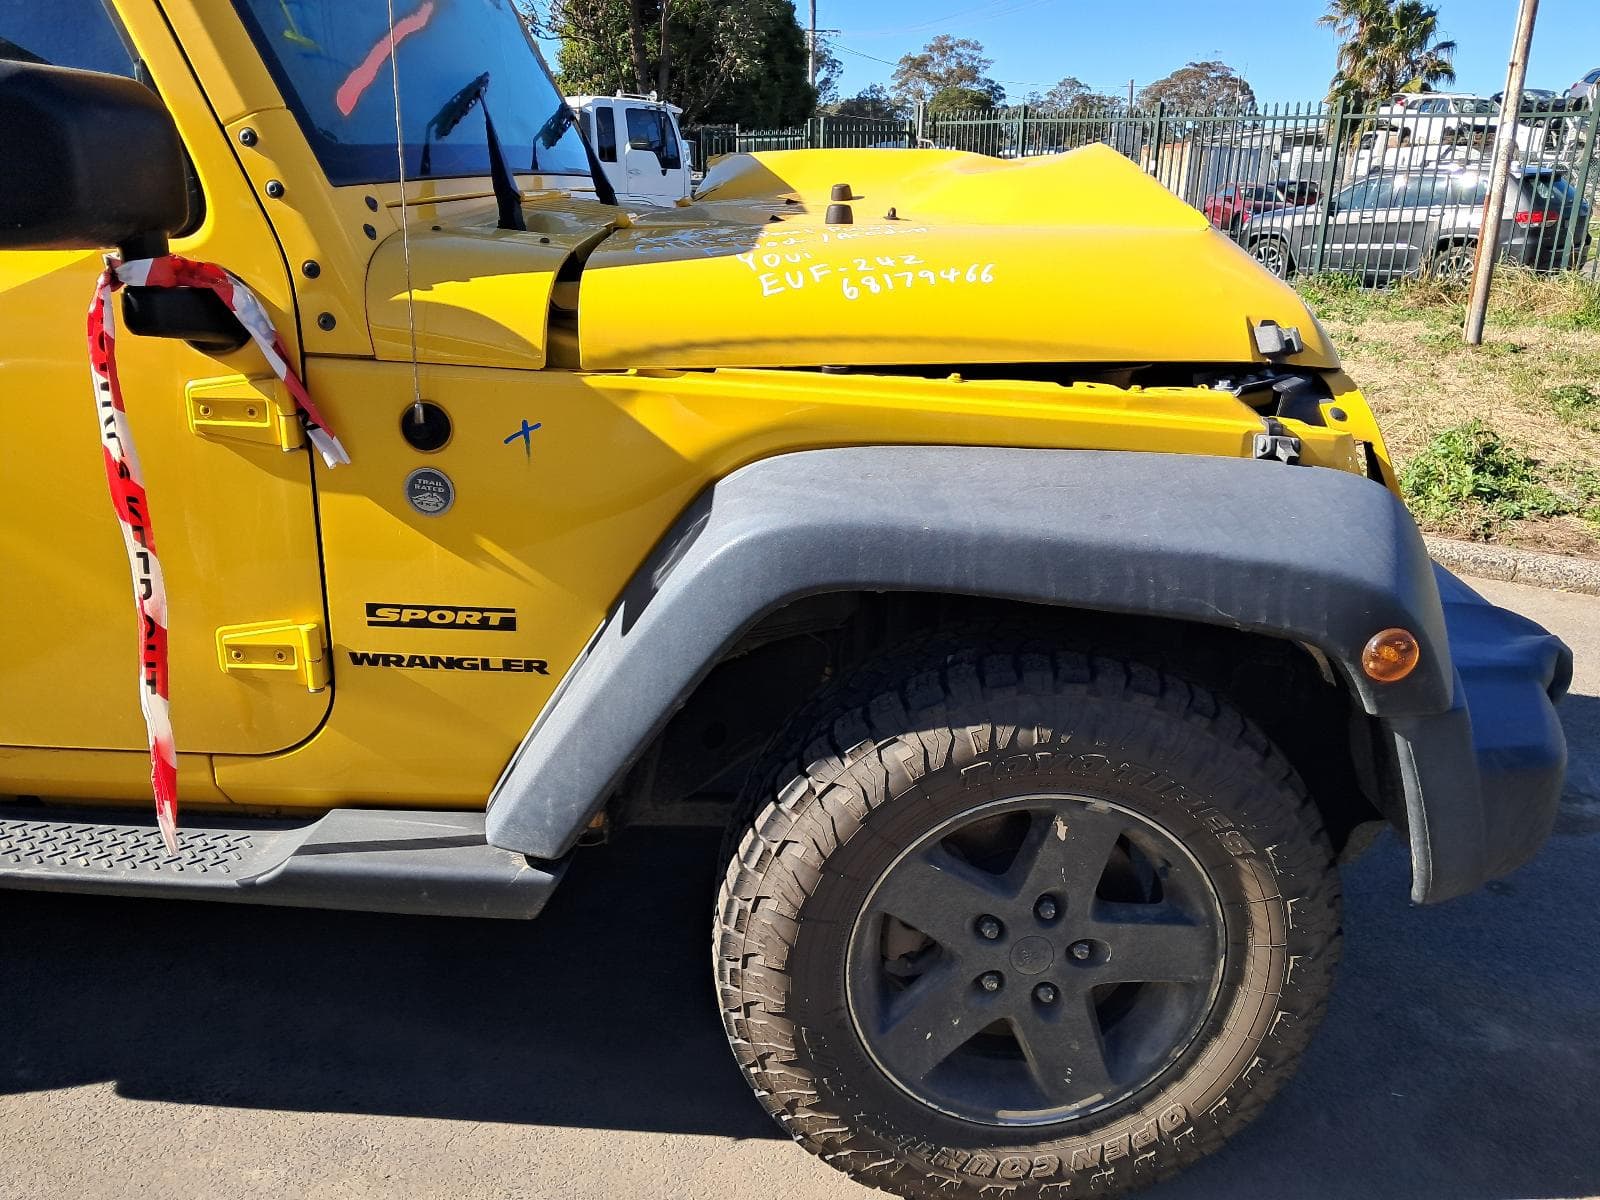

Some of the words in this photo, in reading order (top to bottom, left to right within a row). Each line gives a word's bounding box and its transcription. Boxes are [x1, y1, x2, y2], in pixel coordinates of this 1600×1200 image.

[842, 263, 997, 300] 68179466
[414, 483, 445, 493] RATED
[416, 478, 444, 487] TRAIL
[366, 606, 517, 627] SPORT
[348, 651, 551, 675] WRANGLER
[1072, 1101, 1188, 1174] OPEN
